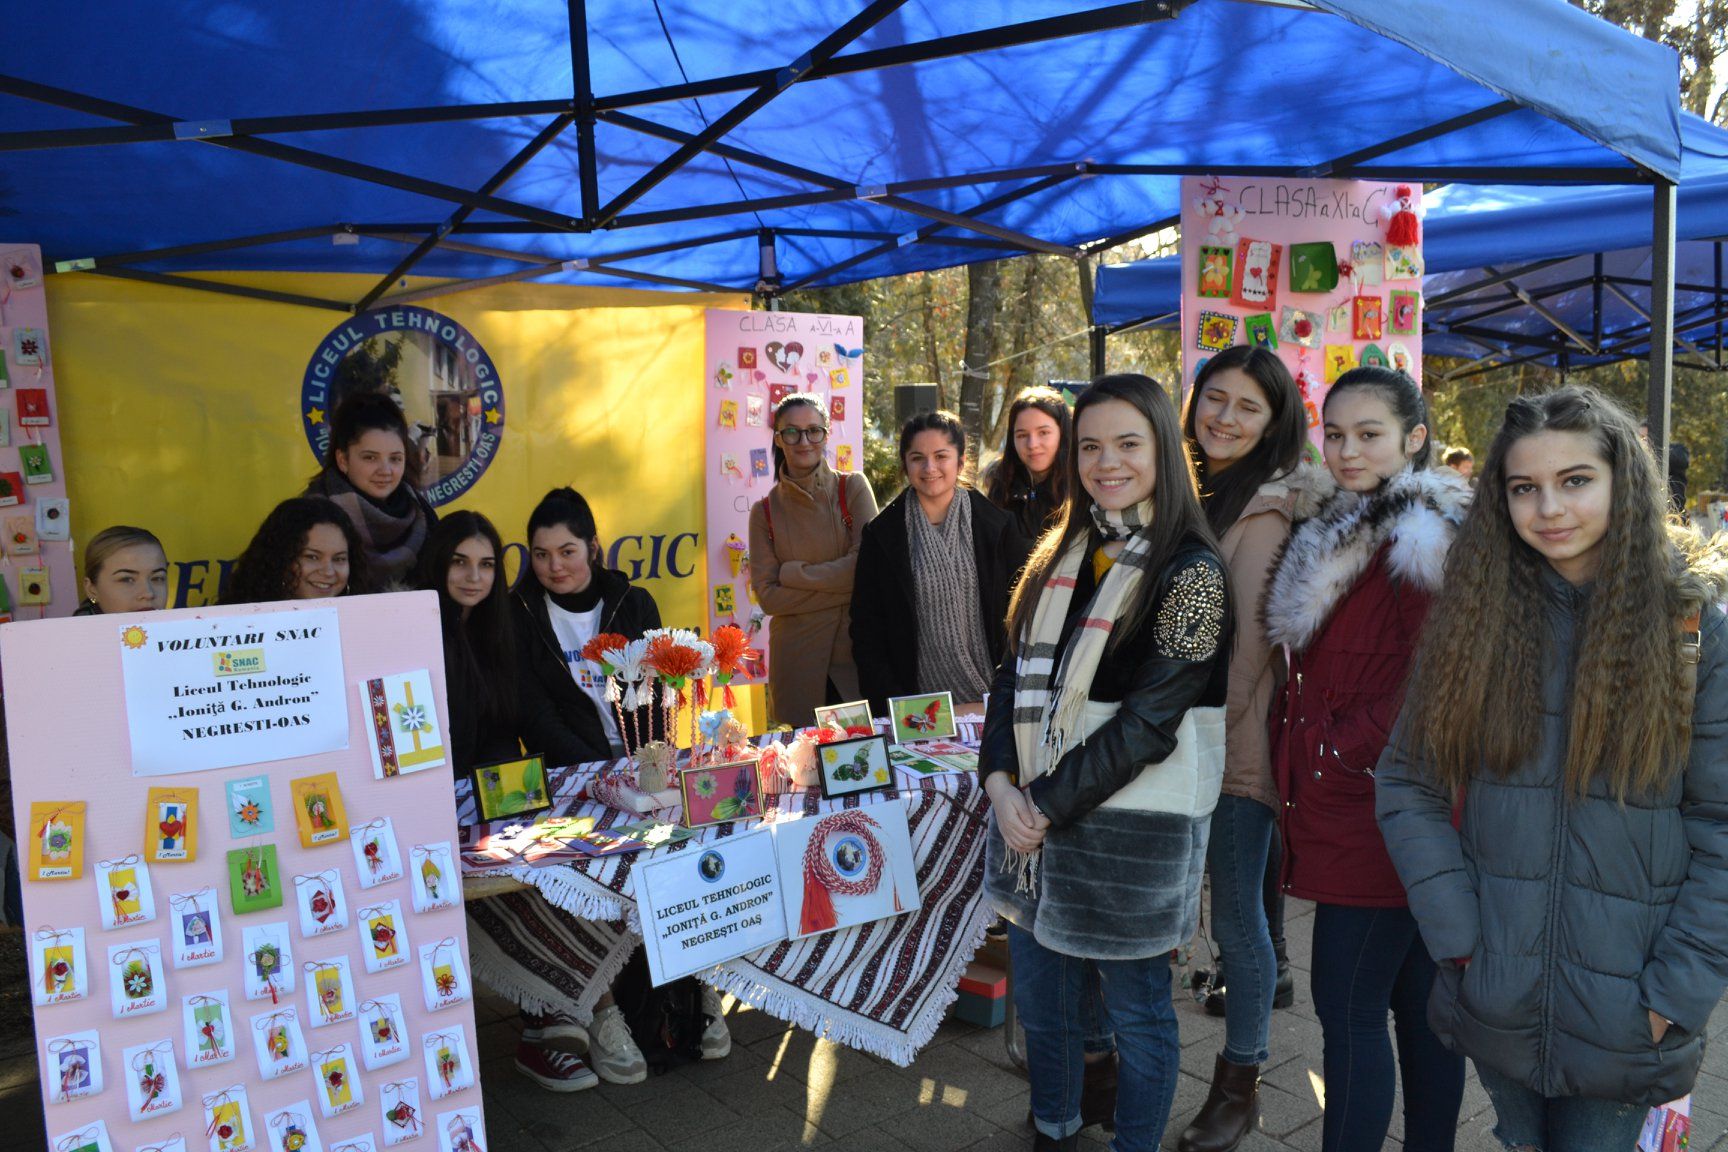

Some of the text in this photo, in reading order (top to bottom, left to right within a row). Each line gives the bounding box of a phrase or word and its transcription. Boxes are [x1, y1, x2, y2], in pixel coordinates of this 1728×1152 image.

[1240, 184, 1317, 218] CLASA
[739, 315, 797, 333] CLASA
[309, 311, 498, 404] LICEUL TEHNOLOGIC
[157, 626, 322, 653] VOLUNTARI SNAC
[232, 657, 260, 668] SNAC
[173, 673, 312, 698] Liceul Tehnologic
[231, 699, 248, 712] G.
[182, 714, 311, 741] NEGRESTI-OAS
[656, 874, 773, 920] LICEUL TEHNOLOGIC
[710, 911, 722, 921] G.
